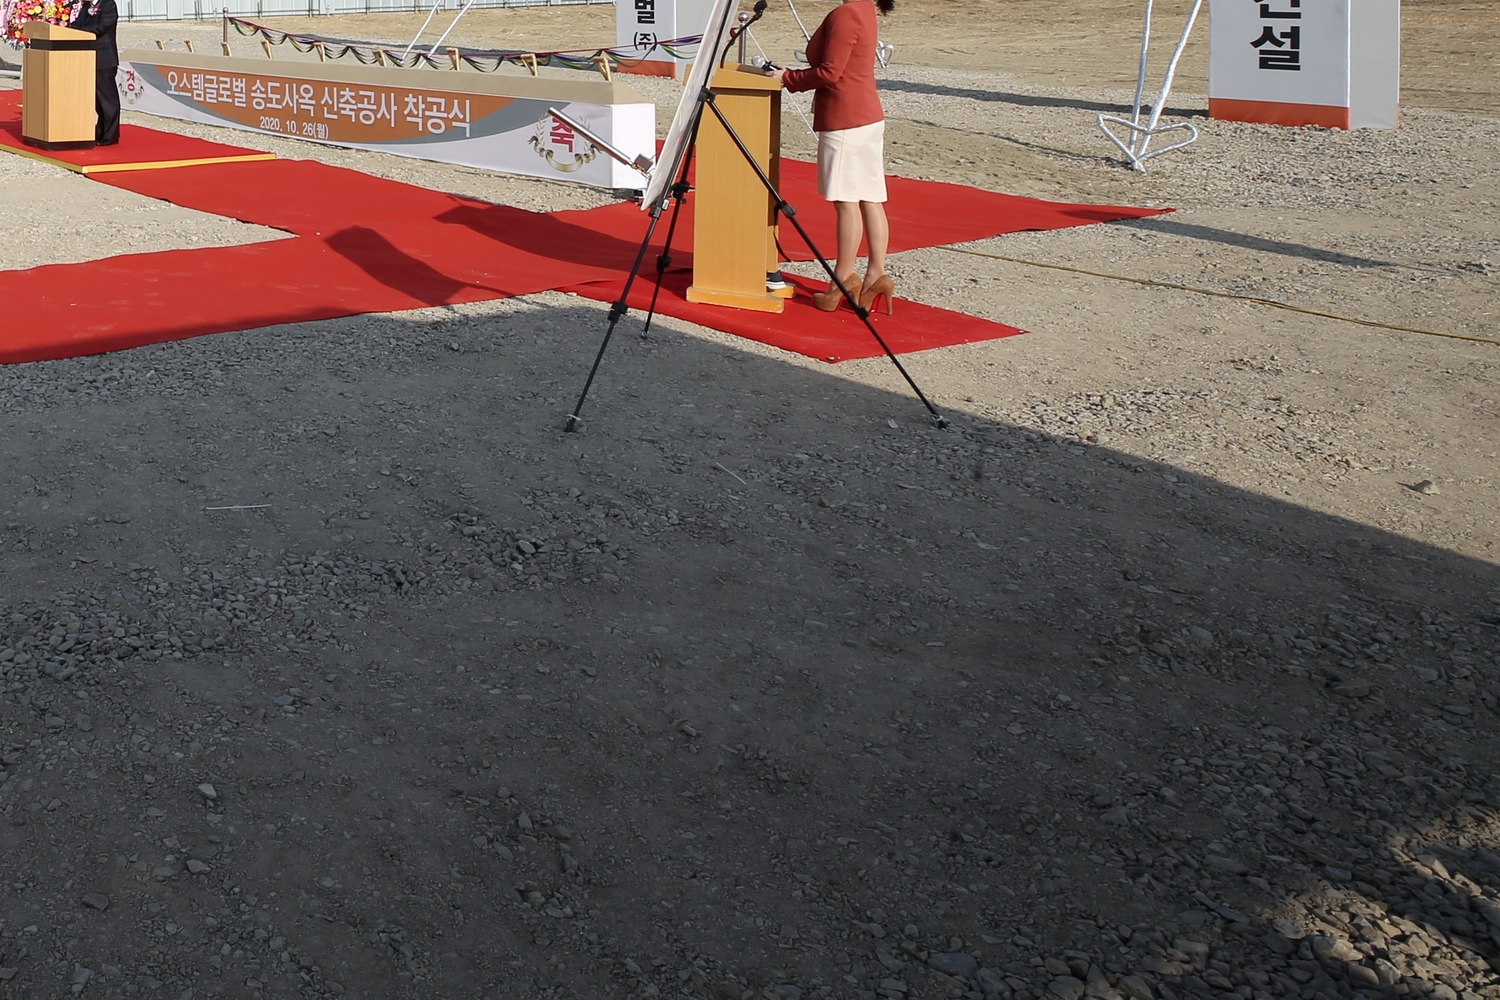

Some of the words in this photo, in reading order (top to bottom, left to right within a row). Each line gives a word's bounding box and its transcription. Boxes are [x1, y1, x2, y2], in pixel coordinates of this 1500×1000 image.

[126, 70, 136, 92] 경
[166, 71, 247, 107] 오스템글로벌
[251, 79, 316, 117] 송도사옥
[321, 87, 398, 127] 신축공사
[403, 94, 472, 138] 착공식
[259, 116, 282, 131] 2020.
[286, 120, 299, 135] 10.
